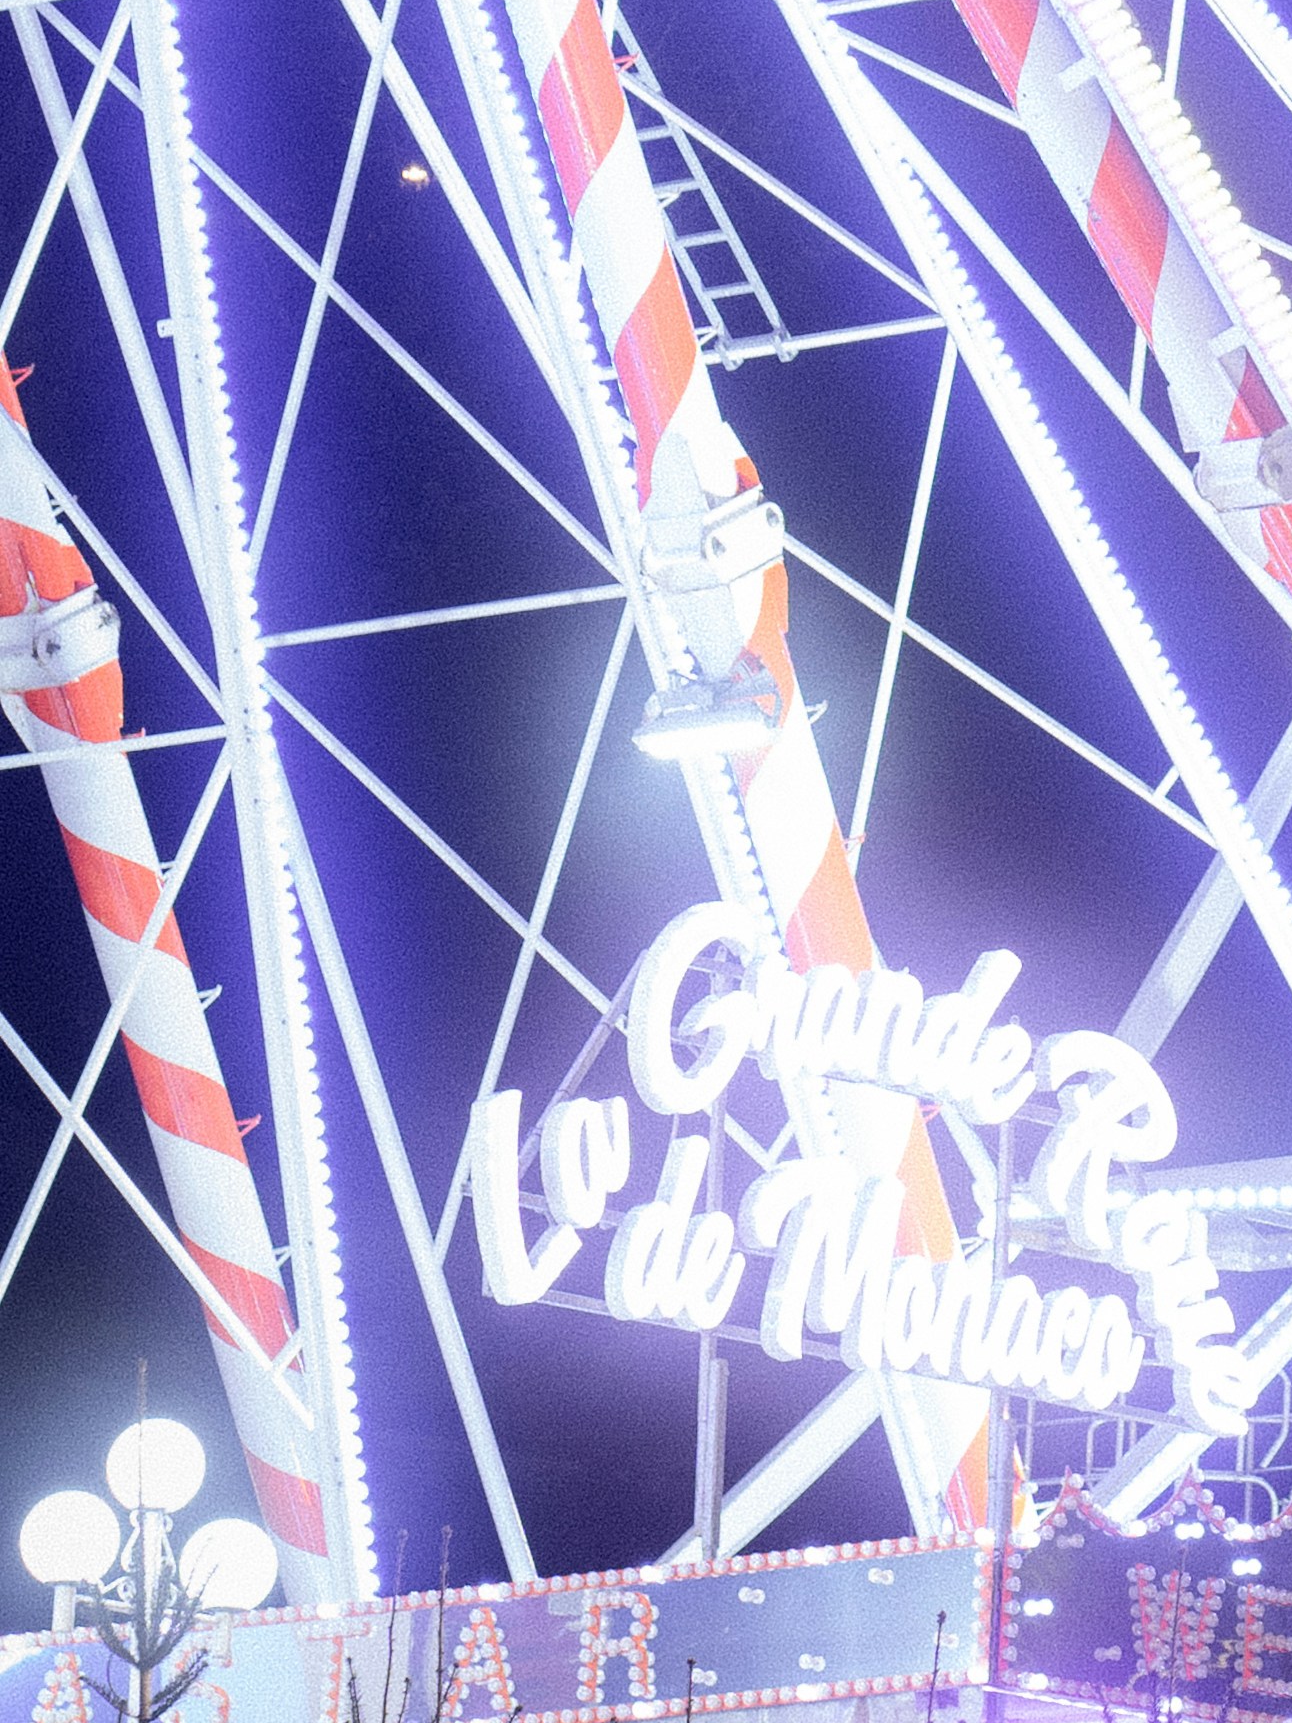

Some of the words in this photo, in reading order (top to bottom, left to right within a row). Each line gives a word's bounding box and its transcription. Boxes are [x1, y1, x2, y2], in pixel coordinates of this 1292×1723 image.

[471, 1088, 631, 1307] La
[627, 900, 1036, 1125] Grande
[605, 1135, 745, 1331] de
[738, 1156, 1146, 1411] Monaco
